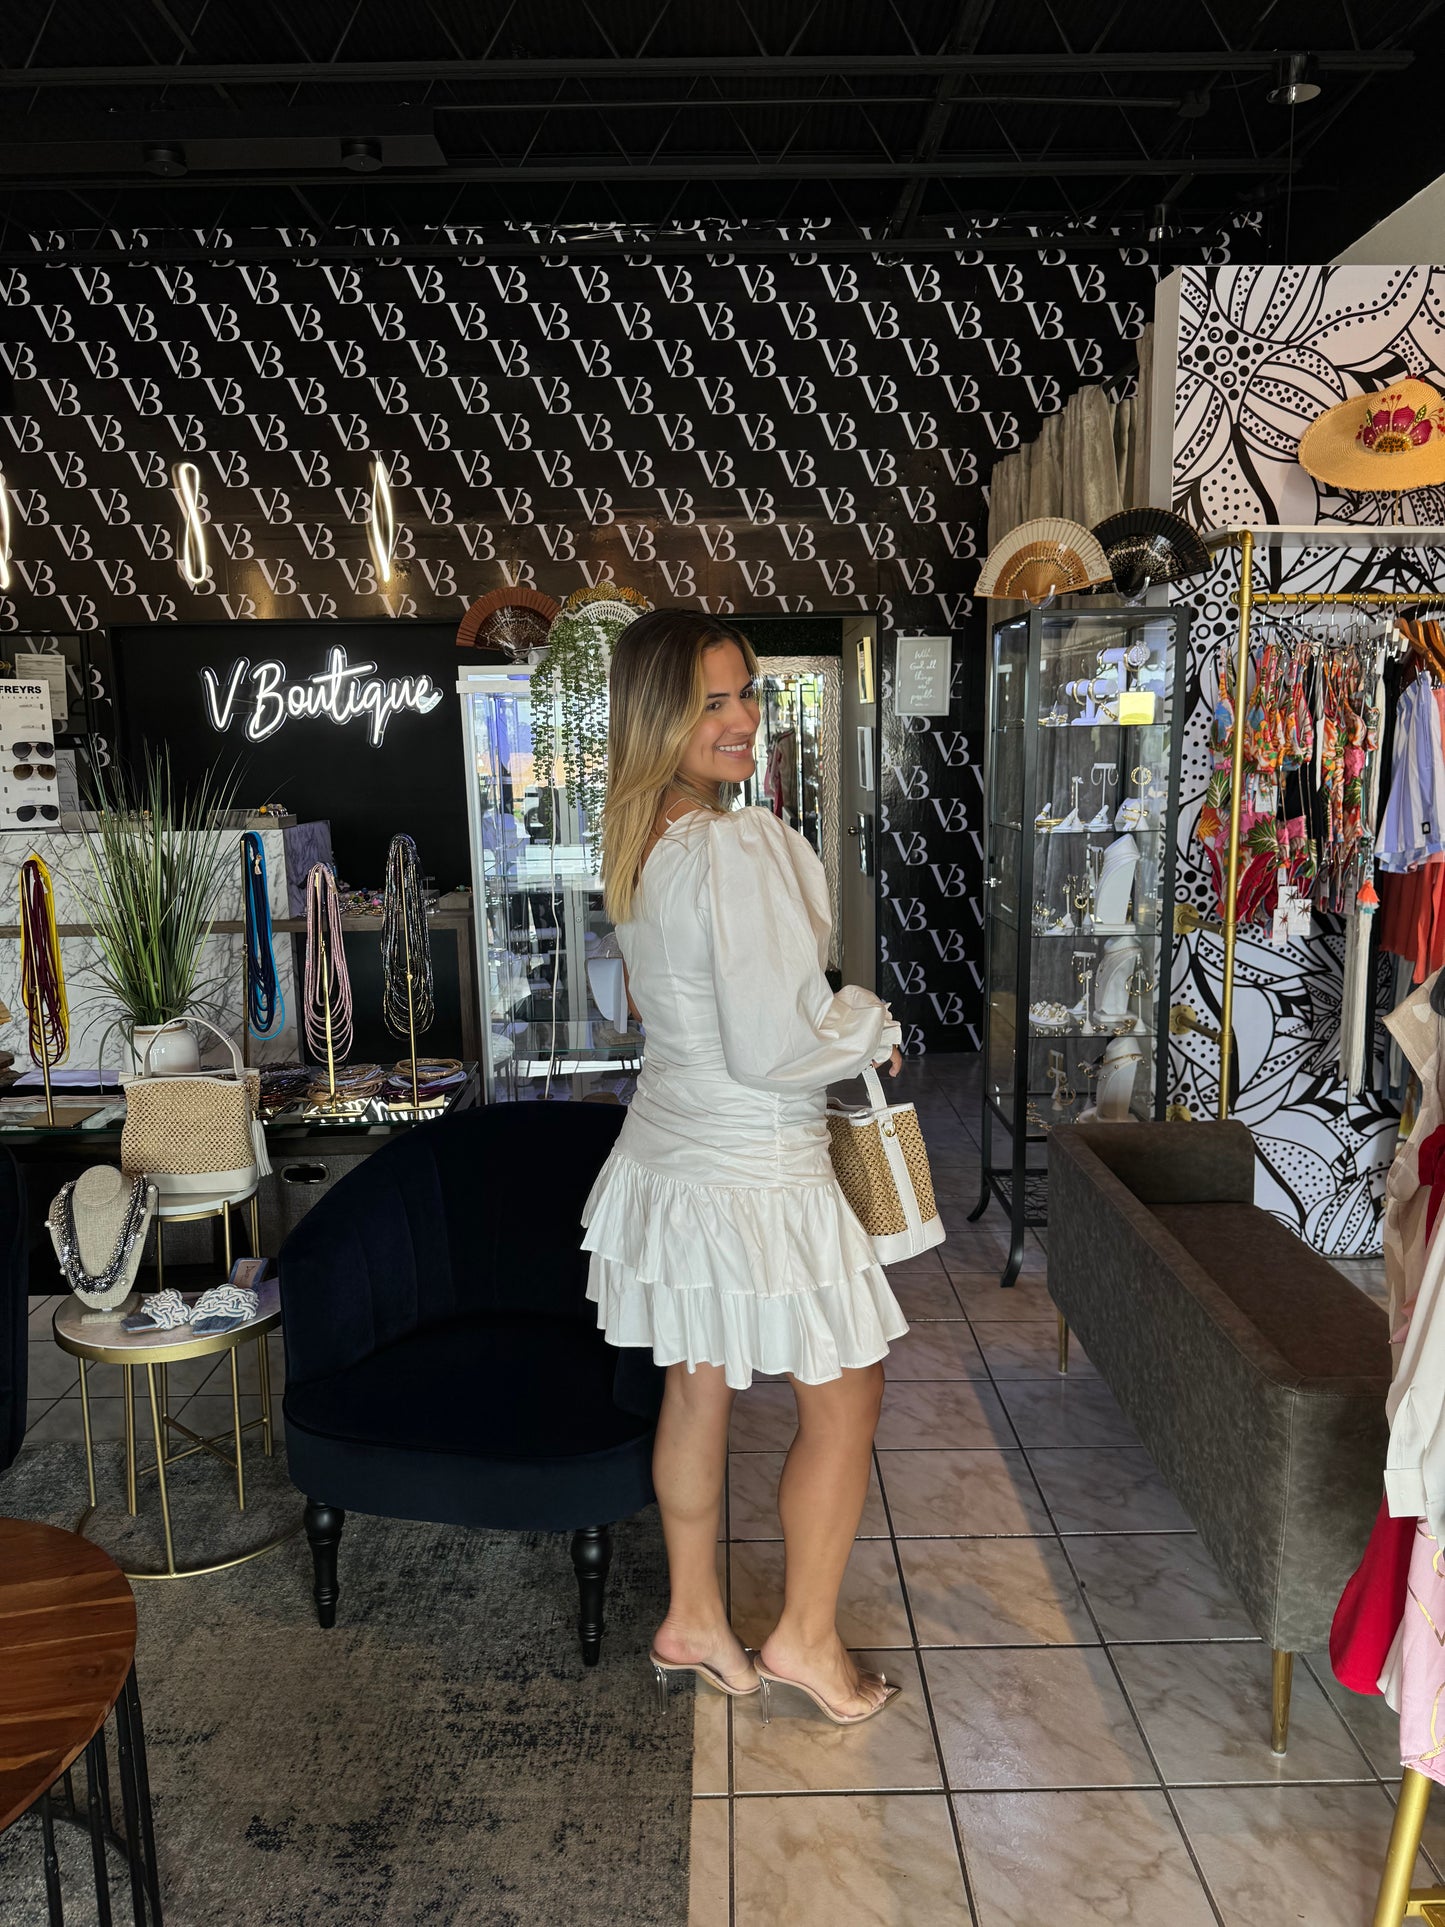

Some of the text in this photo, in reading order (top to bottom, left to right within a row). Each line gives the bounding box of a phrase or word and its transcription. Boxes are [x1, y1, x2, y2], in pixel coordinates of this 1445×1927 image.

[71, 267, 113, 304] VB
[154, 267, 196, 304] VB
[238, 266, 279, 304] VB
[321, 266, 362, 304] VB
[404, 266, 445, 303] VB
[486, 266, 528, 303] VB
[569, 266, 610, 303] VB
[653, 266, 693, 303] VB
[735, 265, 776, 303] VB
[818, 265, 858, 302] VB
[901, 264, 941, 302] VB
[984, 264, 1023, 302] VB
[1066, 265, 1106, 302] VB
[32, 305, 74, 342] VB
[114, 304, 157, 341] VB
[197, 304, 240, 341] VB
[281, 304, 323, 341] VB
[364, 303, 405, 341] VB
[446, 303, 487, 340] VB
[528, 303, 570, 340] VB
[612, 303, 652, 340] VB
[694, 302, 735, 340] VB
[776, 302, 817, 340] VB
[859, 302, 899, 339] VB
[942, 301, 982, 339] VB
[1024, 302, 1063, 339] VB
[1107, 302, 1145, 340] VB
[0, 343, 36, 379] VB
[76, 342, 118, 378] VB
[158, 341, 201, 378] VB
[241, 341, 283, 378] VB
[324, 341, 366, 378] VB
[406, 340, 448, 377] VB
[488, 340, 530, 377] VB
[571, 340, 611, 377] VB
[653, 340, 694, 377] VB
[735, 340, 776, 377] VB
[817, 339, 858, 376] VB
[900, 338, 939, 376] VB
[983, 338, 1021, 376] VB
[1064, 339, 1103, 376] VB
[38, 379, 80, 416] VB
[120, 378, 162, 415] VB
[202, 378, 245, 415] VB
[285, 378, 327, 415] VB
[367, 377, 408, 414] VB
[448, 377, 490, 414] VB
[530, 377, 571, 414] VB
[613, 377, 653, 414] VB
[695, 377, 735, 414] VB
[776, 376, 816, 414] VB
[858, 375, 898, 413] VB
[941, 375, 980, 412] VB
[1022, 376, 1061, 412] VB
[0, 416, 43, 452] VB
[82, 415, 124, 452] VB
[164, 415, 206, 451] VB
[246, 414, 287, 451] VB
[328, 414, 369, 451] VB
[410, 414, 450, 451] VB
[491, 413, 531, 450] VB
[573, 414, 613, 451] VB
[654, 414, 694, 451] VB
[735, 414, 776, 451] VB
[817, 413, 857, 450] VB
[899, 412, 938, 449] VB
[981, 412, 1019, 449] VB
[45, 452, 87, 488] VB
[125, 451, 168, 488] VB
[207, 451, 249, 487] VB
[289, 450, 331, 487] VB
[451, 450, 492, 487] VB
[532, 450, 573, 487] VB
[614, 450, 654, 487] VB
[695, 451, 735, 488] VB
[776, 450, 816, 487] VB
[857, 449, 897, 486] VB
[939, 449, 978, 486] VB
[8, 489, 50, 525] VB
[88, 489, 130, 525] VB
[250, 488, 292, 524] VB
[334, 487, 373, 525] VB
[413, 487, 453, 525] VB
[493, 488, 534, 524] VB
[574, 488, 614, 525] VB
[655, 488, 695, 525] VB
[736, 488, 775, 525] VB
[816, 487, 856, 524] VB
[897, 487, 936, 523] VB
[51, 525, 93, 560] VB
[132, 524, 173, 560] VB
[212, 524, 254, 560] VB
[294, 523, 335, 559] VB
[454, 524, 495, 560] VB
[535, 524, 575, 561] VB
[616, 524, 656, 561] VB
[695, 524, 736, 561] VB
[776, 522, 815, 561] VB
[857, 523, 895, 560] VB
[938, 522, 976, 559] VB
[14, 560, 55, 596] VB
[94, 560, 136, 595] VB
[254, 559, 297, 595] VB
[335, 559, 378, 595] VB
[416, 559, 457, 596] VB
[496, 560, 537, 590] VB
[576, 560, 615, 589] VB
[656, 561, 696, 597] VB
[736, 560, 775, 596] VB
[816, 560, 855, 595] VB
[896, 559, 934, 595] VB
[58, 595, 98, 630] VB
[137, 594, 178, 621] VB
[203, 647, 440, 746] V Boutique
[931, 731, 970, 766] VB
[893, 765, 930, 800] VB
[929, 798, 968, 832] VB
[890, 831, 928, 866] VB
[928, 863, 966, 897] VB
[889, 898, 927, 931] VB
[927, 929, 965, 962] VB
[889, 961, 927, 994] VB
[927, 992, 965, 1025] VB
